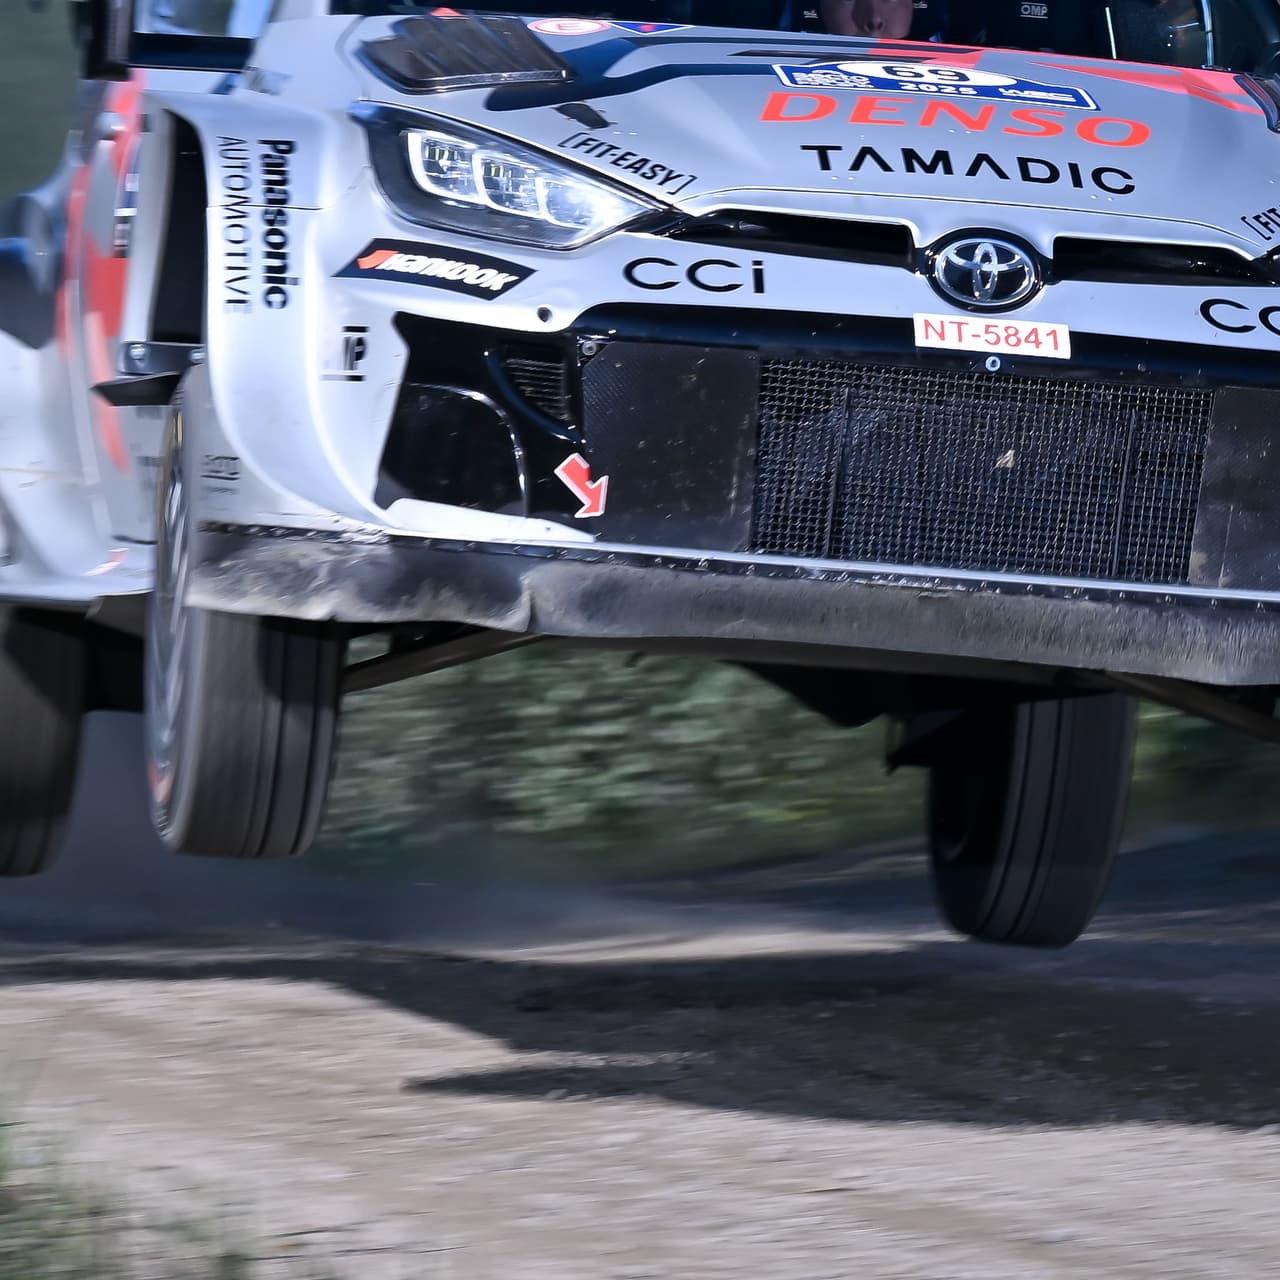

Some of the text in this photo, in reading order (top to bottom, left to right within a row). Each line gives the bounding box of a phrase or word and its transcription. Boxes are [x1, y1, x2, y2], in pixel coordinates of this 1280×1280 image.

[1020, 4, 1048, 16] OMP
[882, 65, 971, 82] 69
[899, 82, 978, 95] 2025
[759, 91, 1152, 147] DENSO
[216, 135, 252, 314] AUTOMOTIVE
[257, 138, 300, 309] Panasonic
[923, 318, 1060, 351] NT-5841
